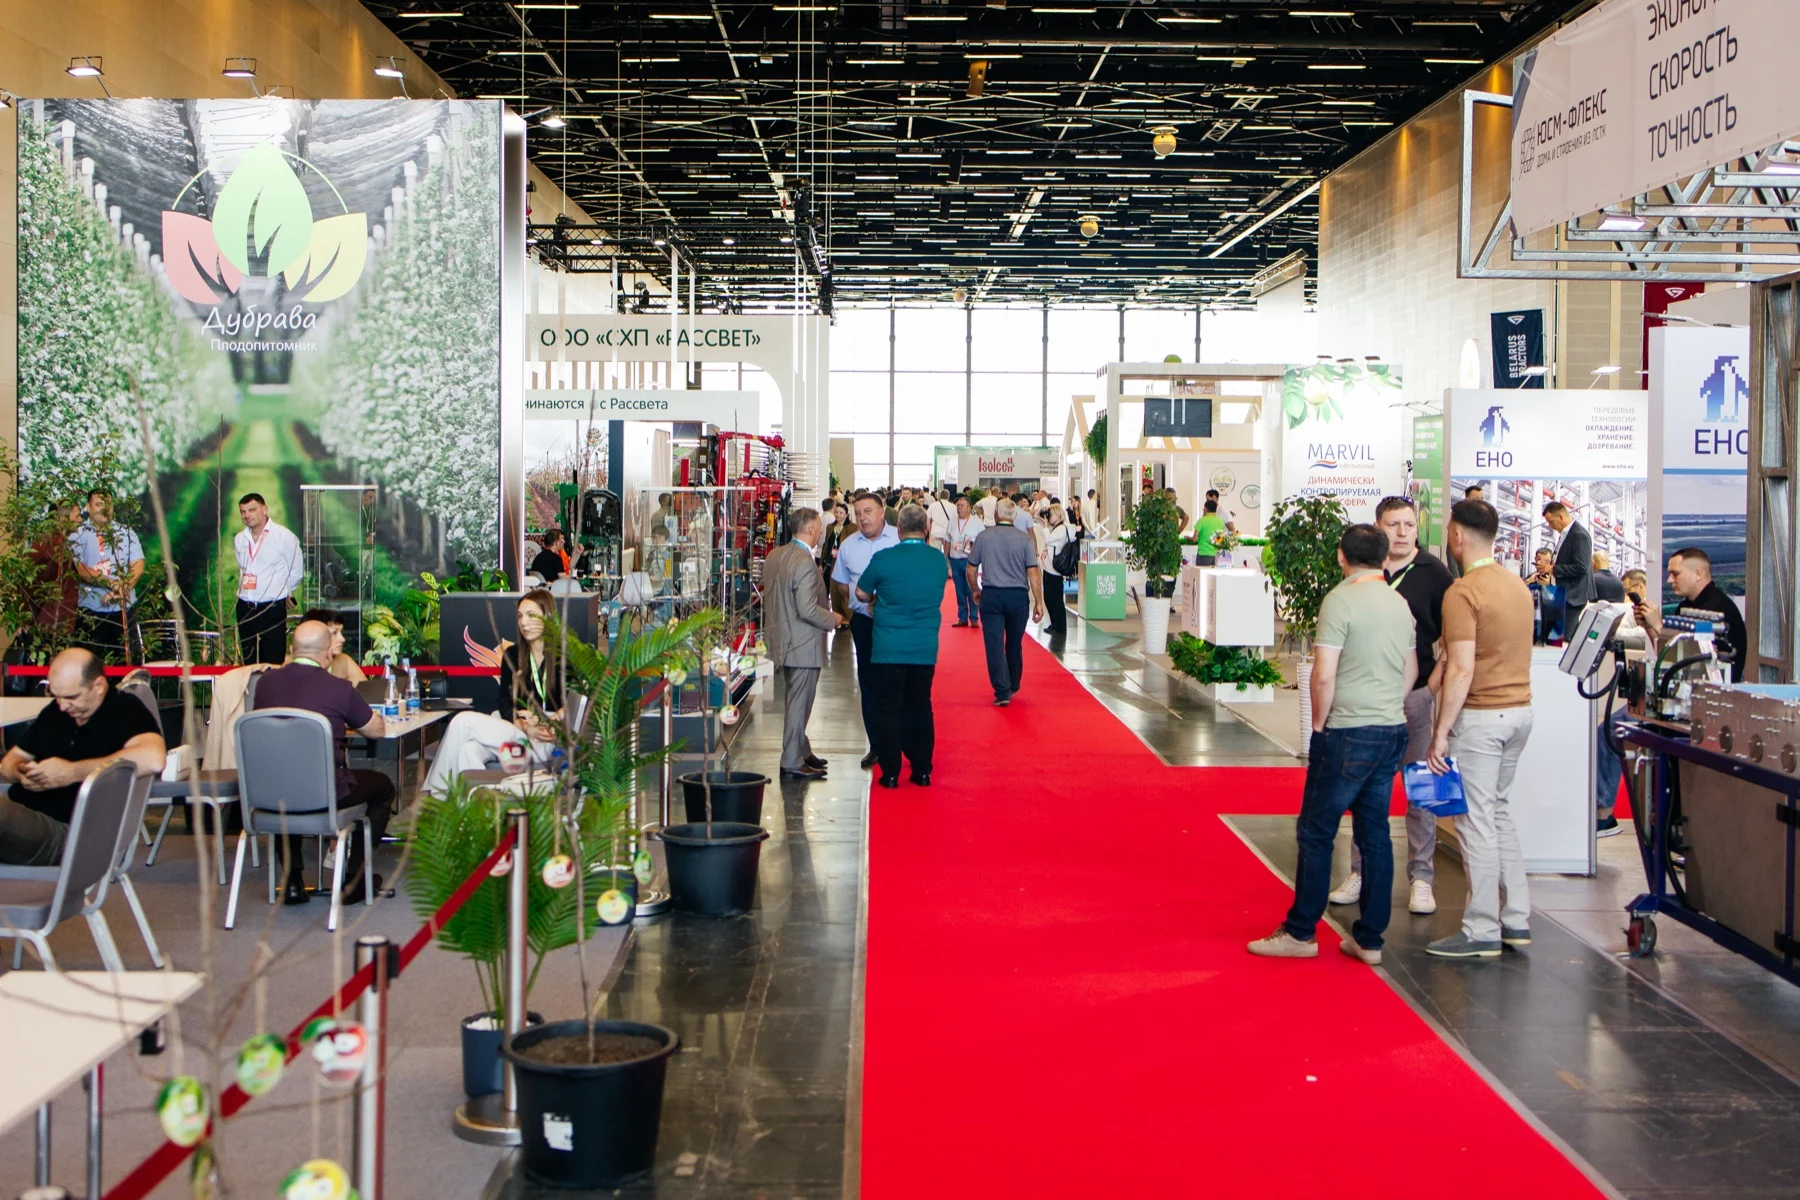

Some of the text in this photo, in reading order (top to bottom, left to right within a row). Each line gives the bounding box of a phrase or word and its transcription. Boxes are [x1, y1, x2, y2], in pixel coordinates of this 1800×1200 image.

[1650, 25, 1738, 100] СКОРОСТЬ
[1537, 88, 1607, 146] ЮСМ-ФЛЕКС
[1648, 93, 1737, 162] ТОЧНОСТЬ
[201, 304, 317, 337] Дубрава
[210, 338, 318, 352] Плодопитомник
[596, 328, 648, 346] «СХП
[1508, 335, 1519, 378] BELARUS
[600, 400, 607, 409] с
[610, 397, 668, 410] Рассвета
[1593, 406, 1636, 414] ПЕРЕДОВЫЕ
[1307, 443, 1375, 461] MARVIL
[1307, 476, 1375, 485] ДИНАМИЧЕСКИ
[1300, 487, 1381, 497] КОНТРОЛИРУЕМАЯ
